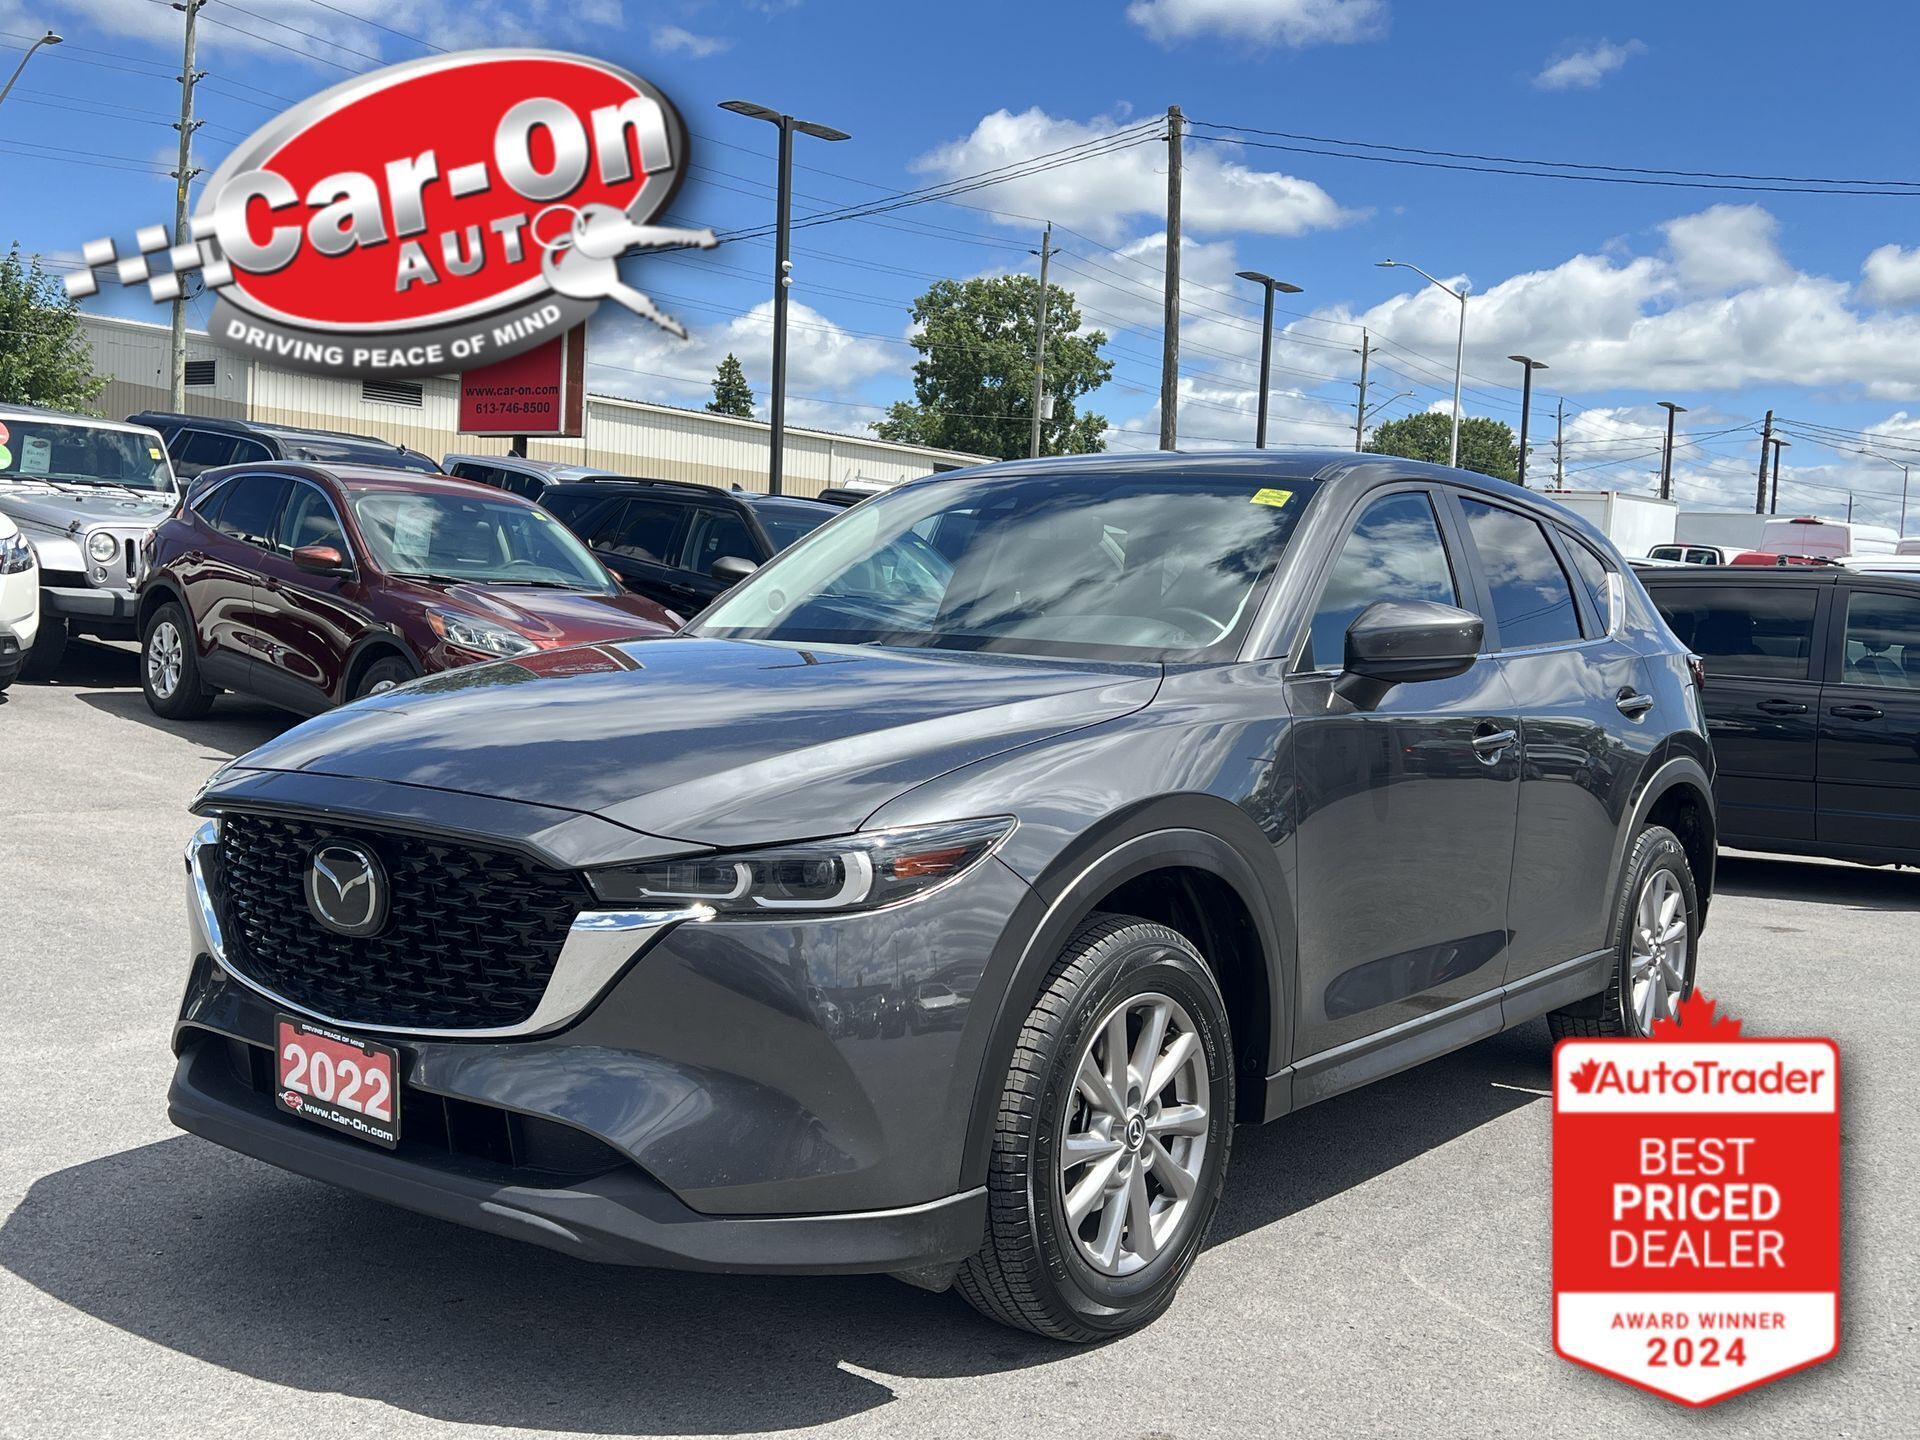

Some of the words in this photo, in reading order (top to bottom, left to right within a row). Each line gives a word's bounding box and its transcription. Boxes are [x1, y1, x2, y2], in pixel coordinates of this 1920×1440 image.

[465, 385, 559, 397] www.car-on.com
[475, 402, 551, 414] 613-746-8500
[283, 1043, 391, 1122] 2022
[304, 1103, 393, 1142] www.Car-On.com
